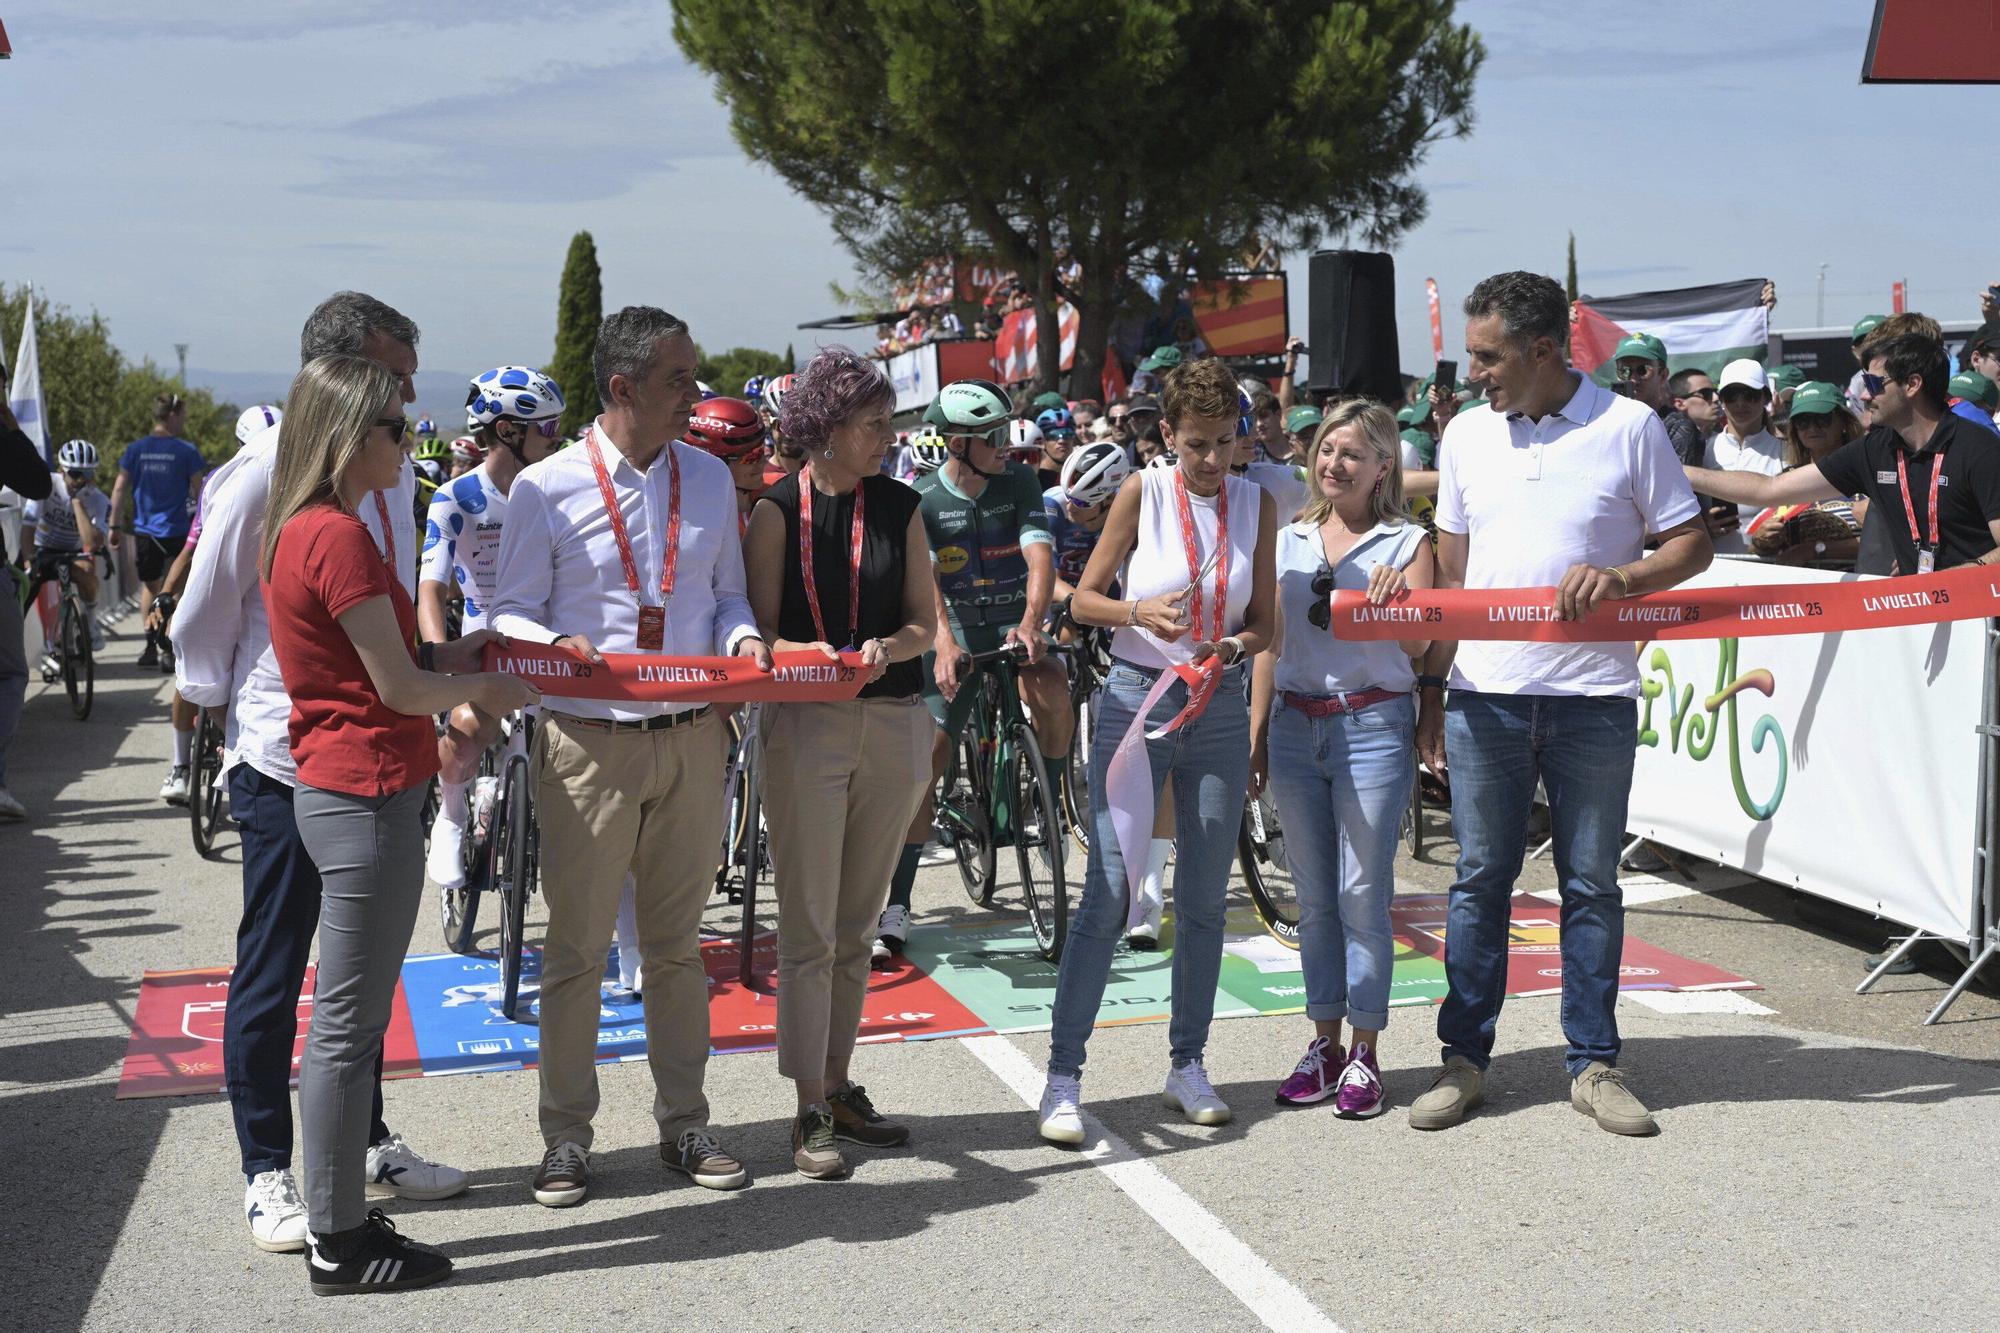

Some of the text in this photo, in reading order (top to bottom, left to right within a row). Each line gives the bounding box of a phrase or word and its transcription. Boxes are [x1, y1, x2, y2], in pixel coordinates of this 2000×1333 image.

[949, 390, 983, 399] TREK
[689, 416, 736, 431] RUDY
[939, 509, 966, 519] Santini
[1863, 589, 1950, 612] LA VUELTA 25
[1353, 607, 1442, 623] LA VUELTA 25
[1488, 606, 1506, 622] LA
[1618, 606, 1700, 622] LA VUELTA 25
[1740, 602, 1823, 620] LA VUELTA 25
[497, 657, 593, 678] LA VUELTA 25
[637, 665, 729, 682] LA VUELTA 25
[772, 666, 856, 682] LA VUELTA 25
